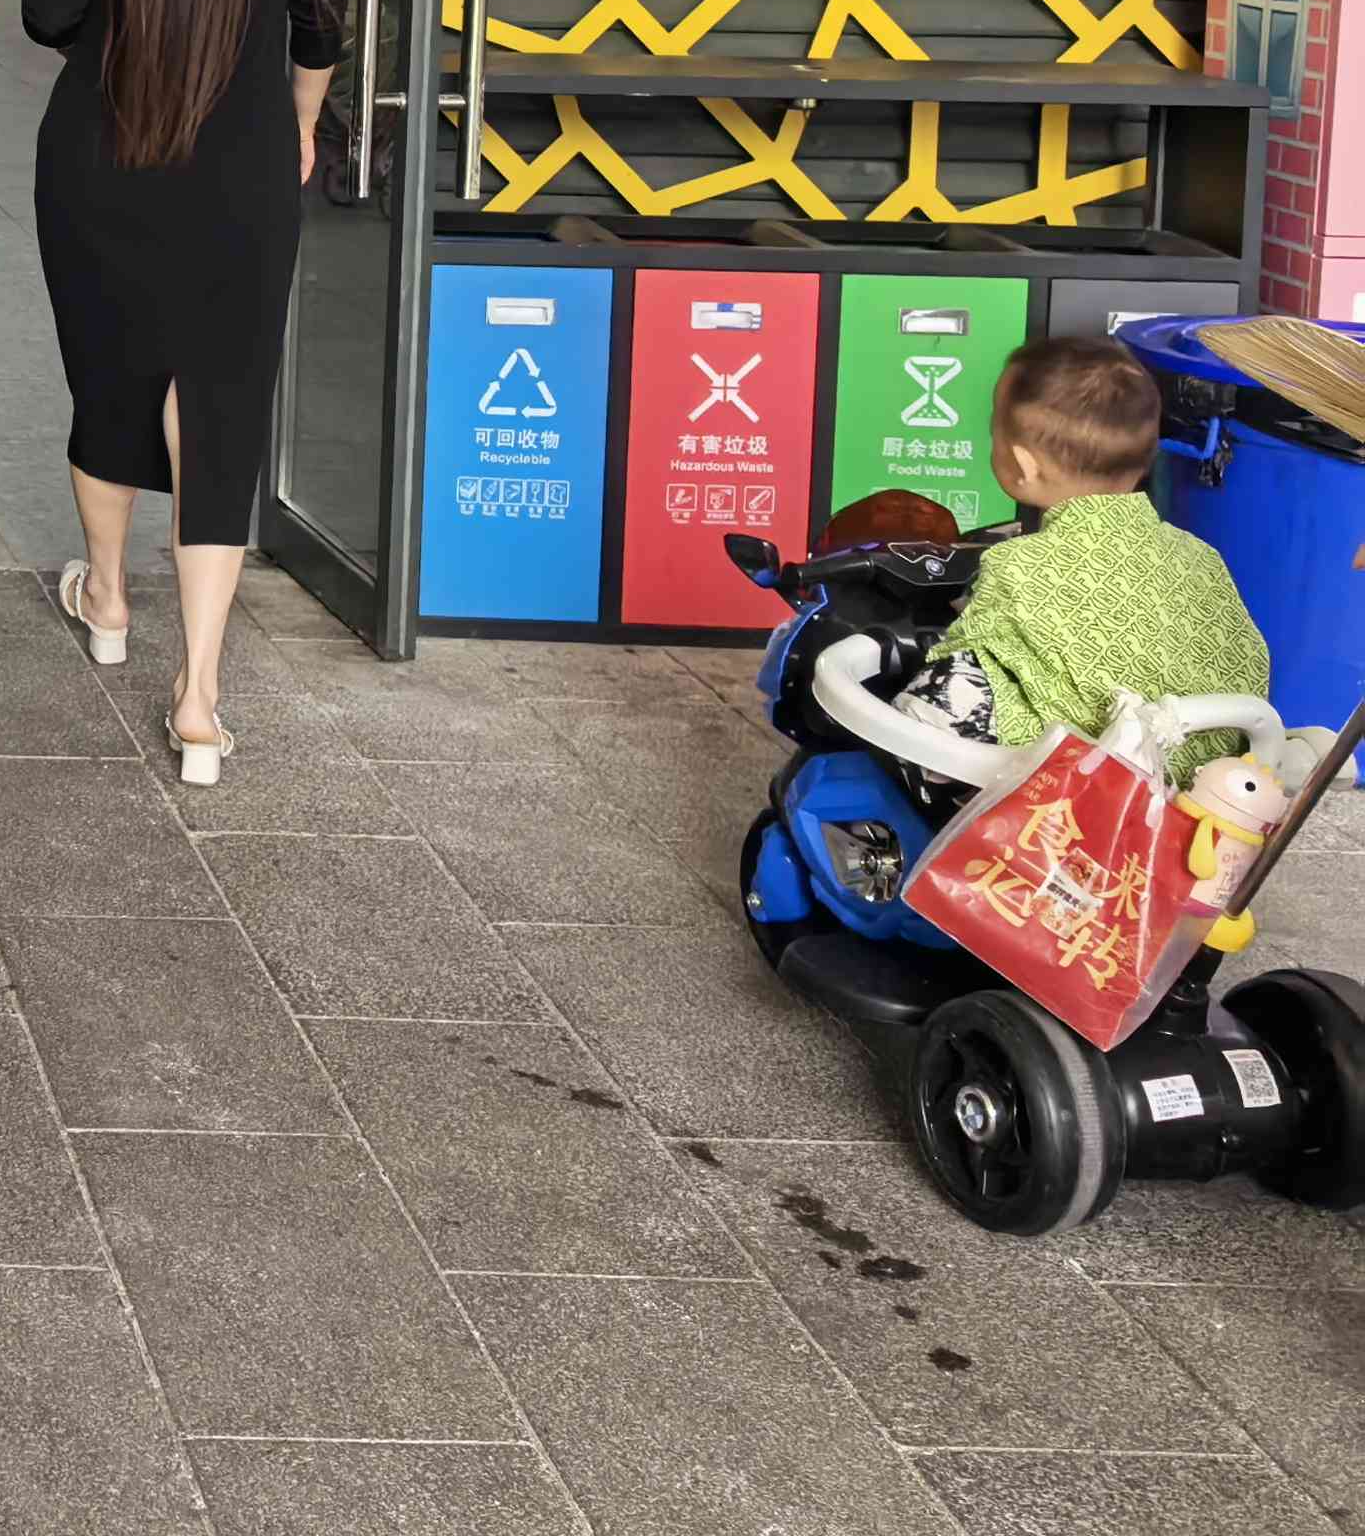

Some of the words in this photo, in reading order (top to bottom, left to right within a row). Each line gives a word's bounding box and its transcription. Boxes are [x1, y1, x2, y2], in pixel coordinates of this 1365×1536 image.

[474, 428, 560, 450] 可回收物
[677, 434, 768, 456] 有害垃圾
[882, 437, 974, 460] 厨余垃圾
[479, 450, 551, 465] Recyclable
[670, 458, 734, 473] Hazardous
[737, 461, 774, 474] Waste
[888, 463, 919, 477] Food
[923, 464, 966, 478] Waste
